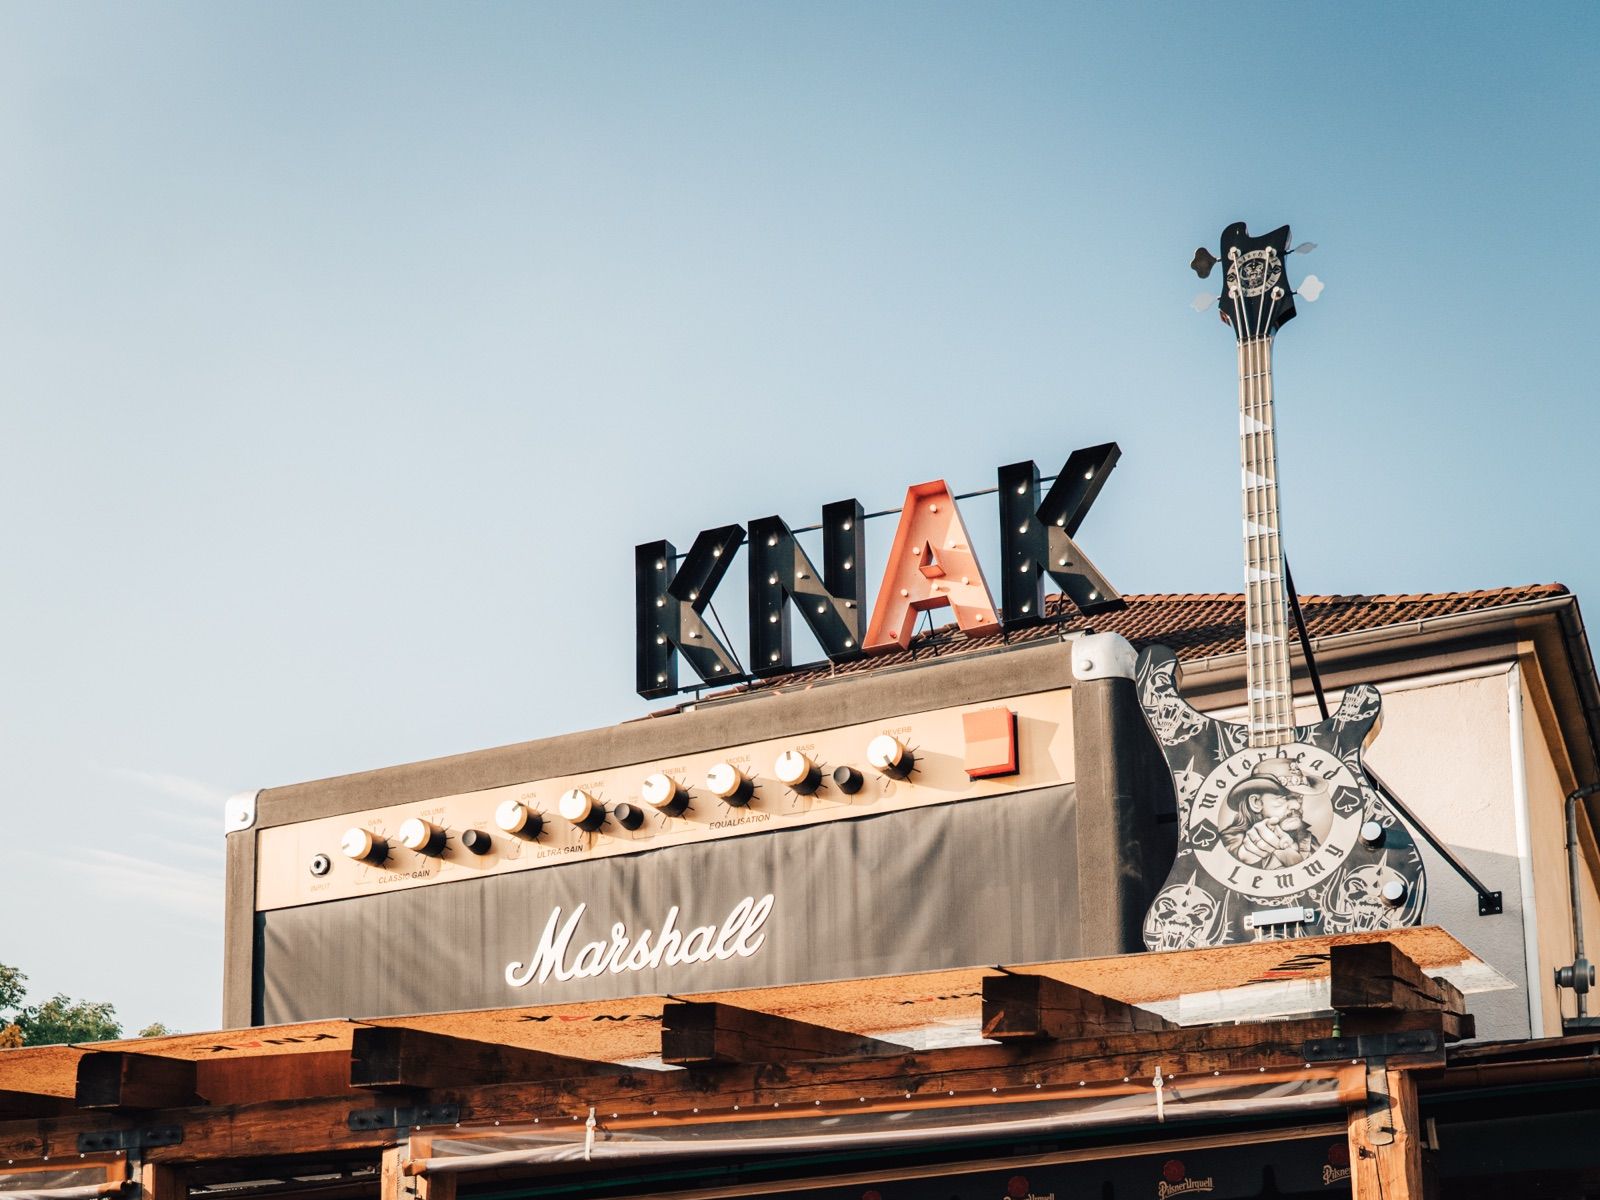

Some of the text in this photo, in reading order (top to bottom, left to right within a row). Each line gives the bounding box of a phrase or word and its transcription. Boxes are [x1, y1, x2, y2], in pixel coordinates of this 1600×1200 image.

[635, 441, 1128, 700] KNAK
[882, 726, 912, 736] REVERB
[795, 743, 815, 751] BASS
[725, 755, 750, 764] MIDDLE
[661, 767, 687, 775] TREBLE
[577, 781, 605, 790] VOLUME
[421, 807, 446, 816] VOLUME
[709, 813, 771, 830] EQUALISATION
[537, 845, 584, 859] ULTRA GAIN
[1227, 843, 1344, 889] Lemmy
[378, 870, 430, 884] CLASSIC GAIN
[310, 883, 330, 892] INPUT
[505, 894, 775, 987] Marshall
[1159, 1177, 1212, 1200] Pilsner Urquell
